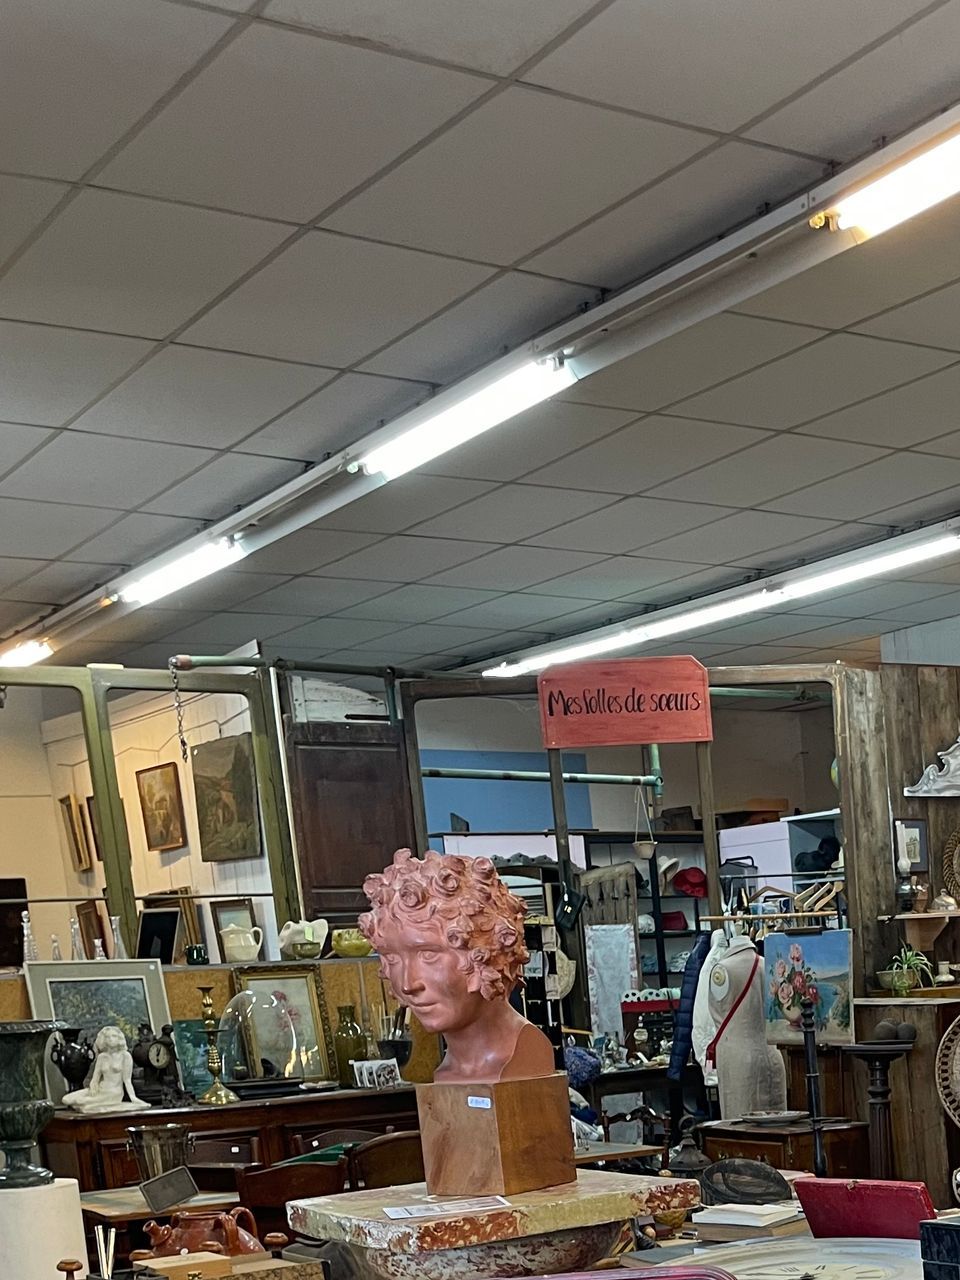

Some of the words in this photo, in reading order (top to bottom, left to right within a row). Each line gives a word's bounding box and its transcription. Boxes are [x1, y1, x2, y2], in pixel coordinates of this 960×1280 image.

[548, 689, 582, 716] Mes
[583, 688, 623, 714] folles
[624, 687, 646, 712] de
[650, 692, 700, 712] sœurs
